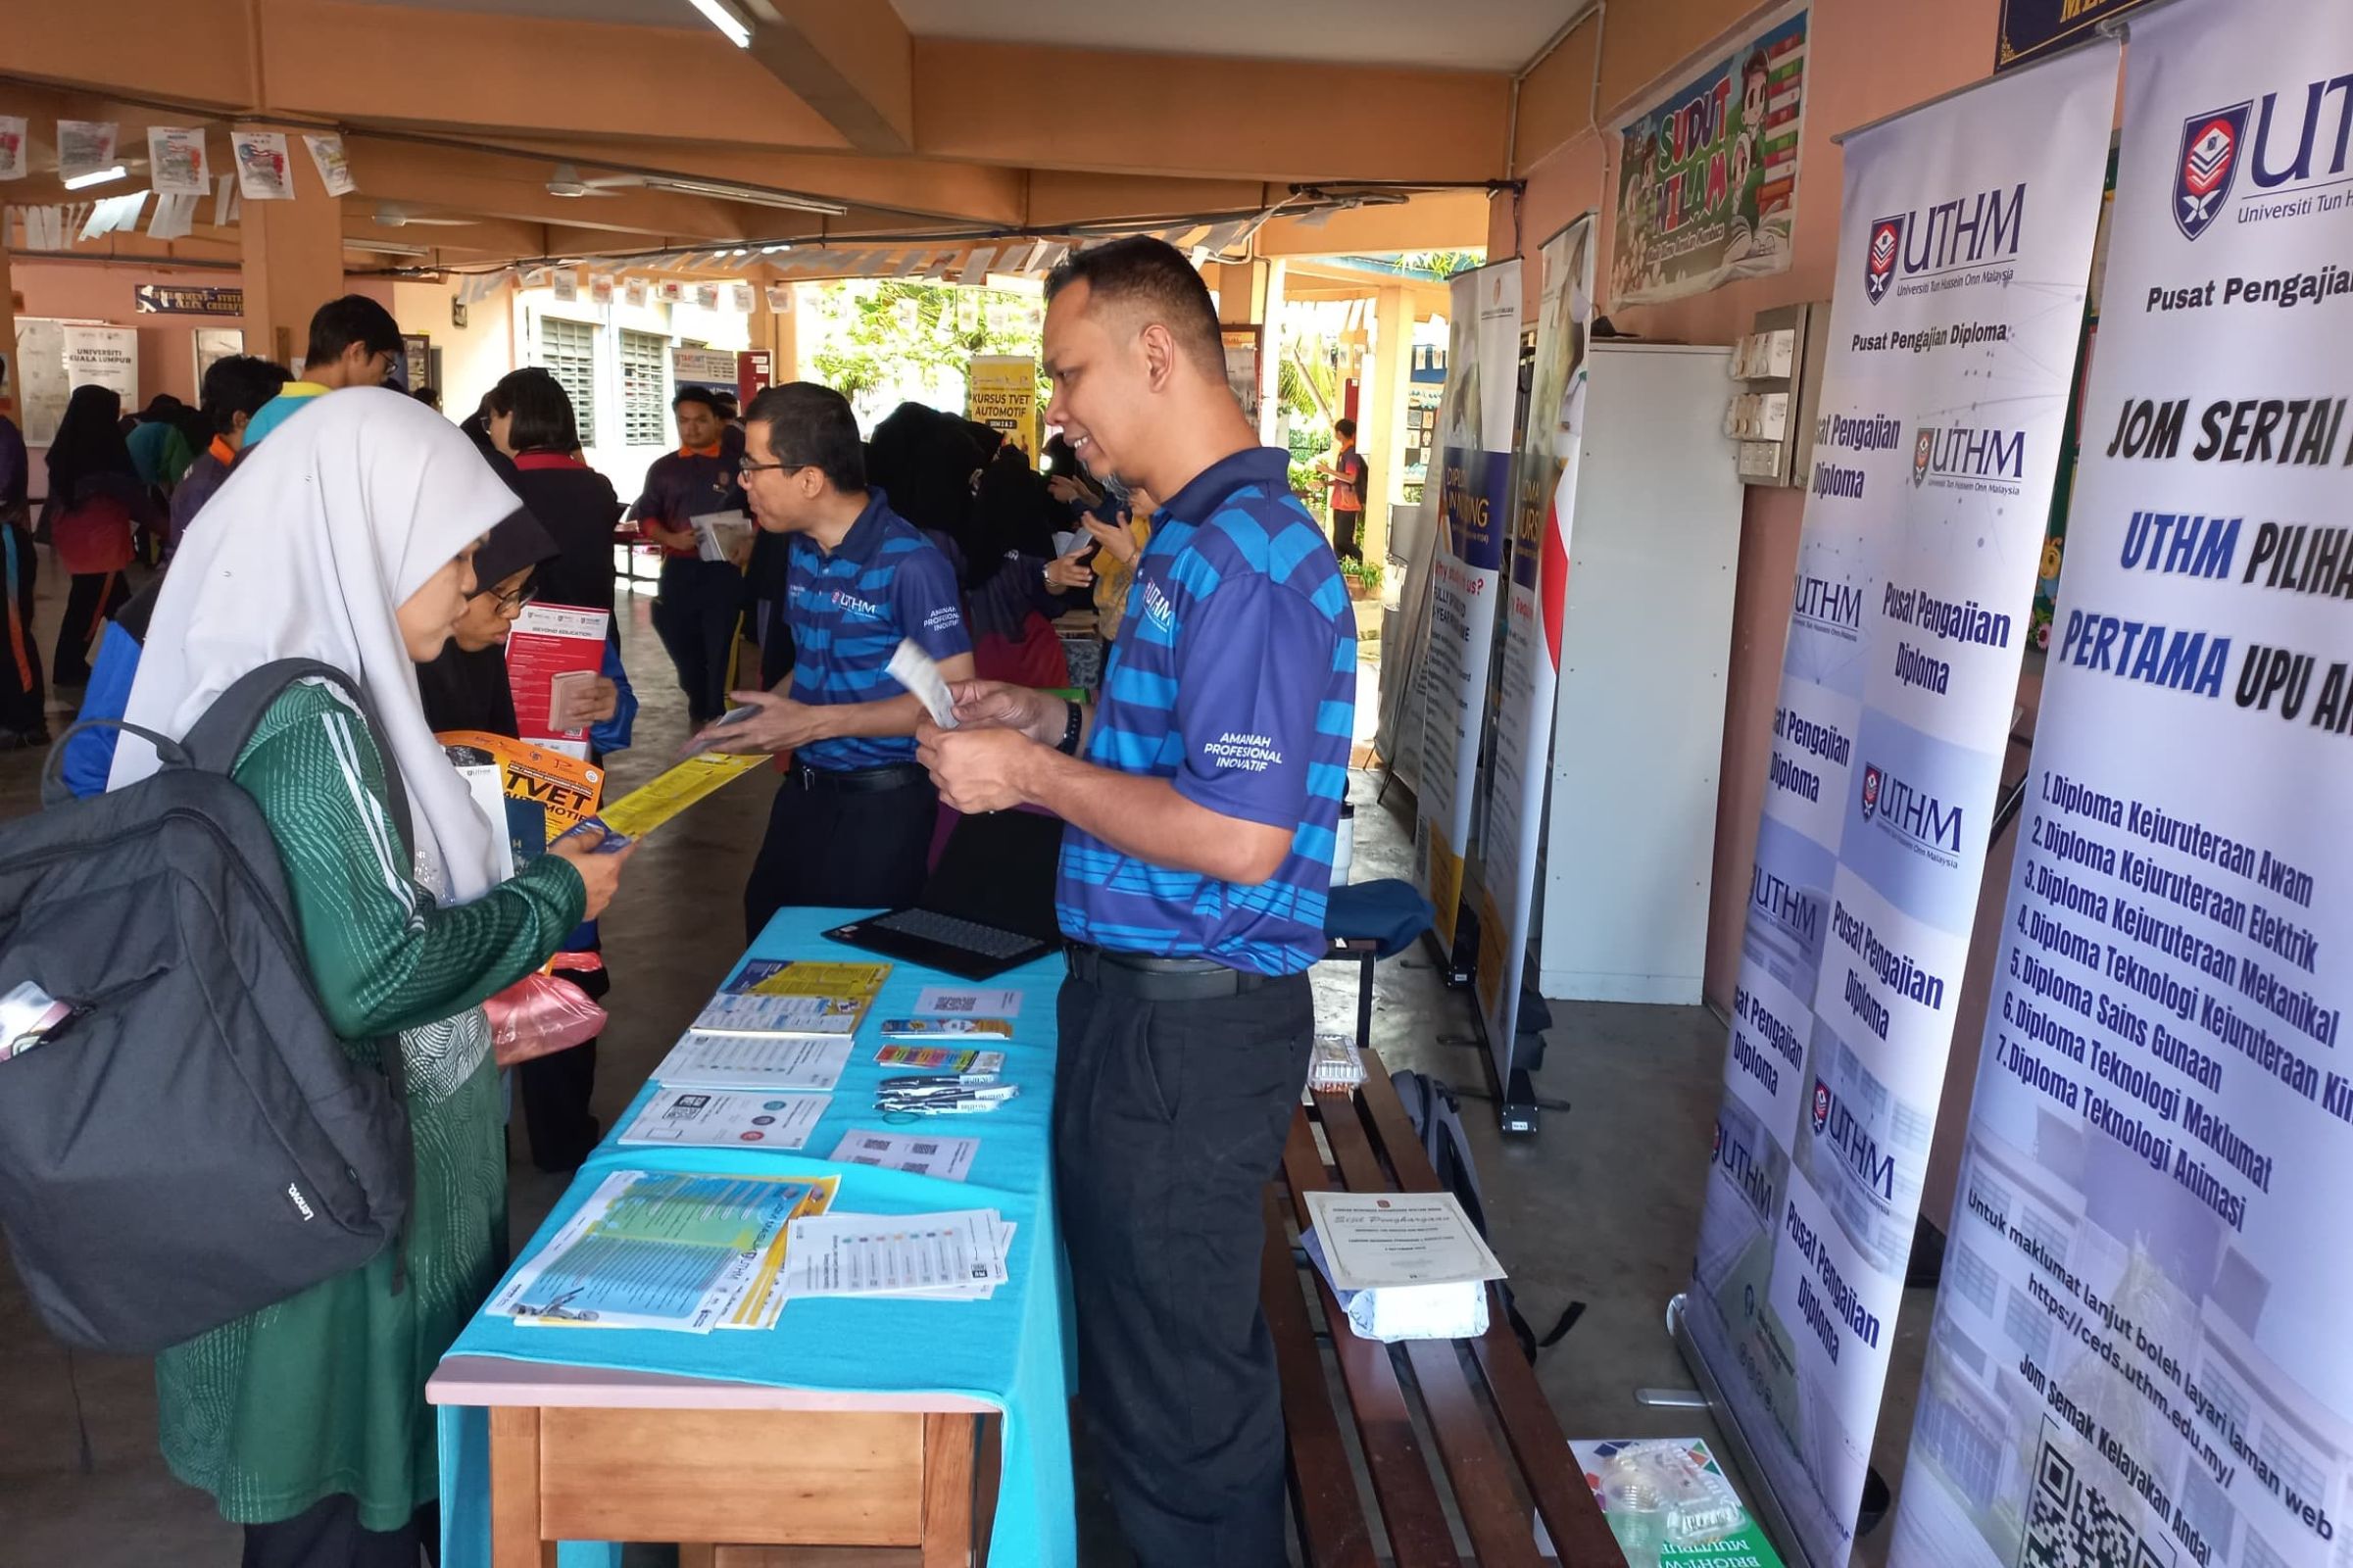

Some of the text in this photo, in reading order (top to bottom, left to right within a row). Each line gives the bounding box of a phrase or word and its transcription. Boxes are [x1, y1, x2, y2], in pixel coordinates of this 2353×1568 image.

[1658, 76, 1732, 172] SUDUT
[1653, 149, 1728, 238] NILAM
[2237, 198, 2312, 224] Universiti
[2317, 192, 2341, 214] Tun
[1903, 182, 2027, 274] UTHM
[1897, 268, 2014, 297] Universiti Tun Hussein Onn Malaysia
[2146, 279, 2216, 314] Pusat
[77, 348, 123, 357] UNIVERSITI
[99, 356, 131, 365] LUMPUR
[1851, 321, 2007, 354] Pusat Pengajian Diploma
[972, 393, 1031, 406] KURSUS TVET
[975, 406, 1027, 418] AUTOMOTIF
[1831, 414, 1901, 452] Pengajian
[2107, 397, 2348, 466] JOM SERTAI
[1813, 462, 1865, 500] Diploma
[1932, 427, 2026, 478] UTHM
[1975, 481, 1987, 492] Onn
[1987, 483, 2020, 497] Malaysia
[2120, 511, 2244, 579] UTHM
[558, 628, 592, 638] EDUCATION
[840, 593, 877, 615] UTHM
[1795, 575, 1863, 628] UTHM
[1883, 581, 1917, 625] Pusat
[1916, 589, 2012, 649] Pengajian
[1894, 640, 1951, 696] Diploma
[2060, 610, 2231, 699] PERTAMA
[2234, 644, 2316, 721] UPU
[1203, 743, 1283, 764] PROFESIONAL
[1215, 757, 1268, 773] INOVATIF
[1219, 732, 1272, 748] AMANAH
[1787, 710, 1851, 768] Pengajian
[504, 790, 588, 823] AUTMOTIF
[506, 769, 592, 811] TVET
[1770, 751, 1820, 804] Diploma
[1880, 770, 1963, 854] UTHM
[2127, 800, 2256, 880] Kejuruteraan
[2257, 850, 2315, 908] Awam
[1755, 872, 1817, 943] UTHM
[2119, 849, 2246, 934] Kejuruteraan
[2248, 903, 2320, 975] Elektrik
[1832, 900, 1864, 953] Pusat
[1862, 927, 1945, 1010] Pengajian
[2112, 897, 2238, 988] Kejuruteraan
[2238, 957, 2340, 1049] Mekanikal
[1749, 1003, 1804, 1073] Pengajian
[1844, 966, 1890, 1042] Diploma
[2106, 945, 2199, 1021] Teknologi
[2200, 993, 2320, 1102] Kejuruteraan
[1733, 1030, 1779, 1098] Diploma
[2096, 992, 2148, 1049] Sains
[2151, 1023, 2223, 1095] Gunaan
[1829, 1092, 1895, 1201] UTHM
[2090, 1038, 2181, 1123] Teknologi
[2181, 1096, 2273, 1195] Maklumat
[1722, 1132, 1773, 1222] UTHM
[2083, 1086, 2174, 1173] Teknologi
[2173, 1147, 2247, 1234] Animasi
[1786, 1199, 1818, 1267] Pusat
[1817, 1244, 1881, 1349] Pengajian
[1797, 1274, 1840, 1367] Diploma
[1967, 1186, 2335, 1543] Untuk maklumat lanjut boleh layari laman web
[2028, 1273, 2235, 1491] https://ceds.uthm.edu.my/
[2019, 1352, 2212, 1567] Jom Semak Kelayakan Anda!
